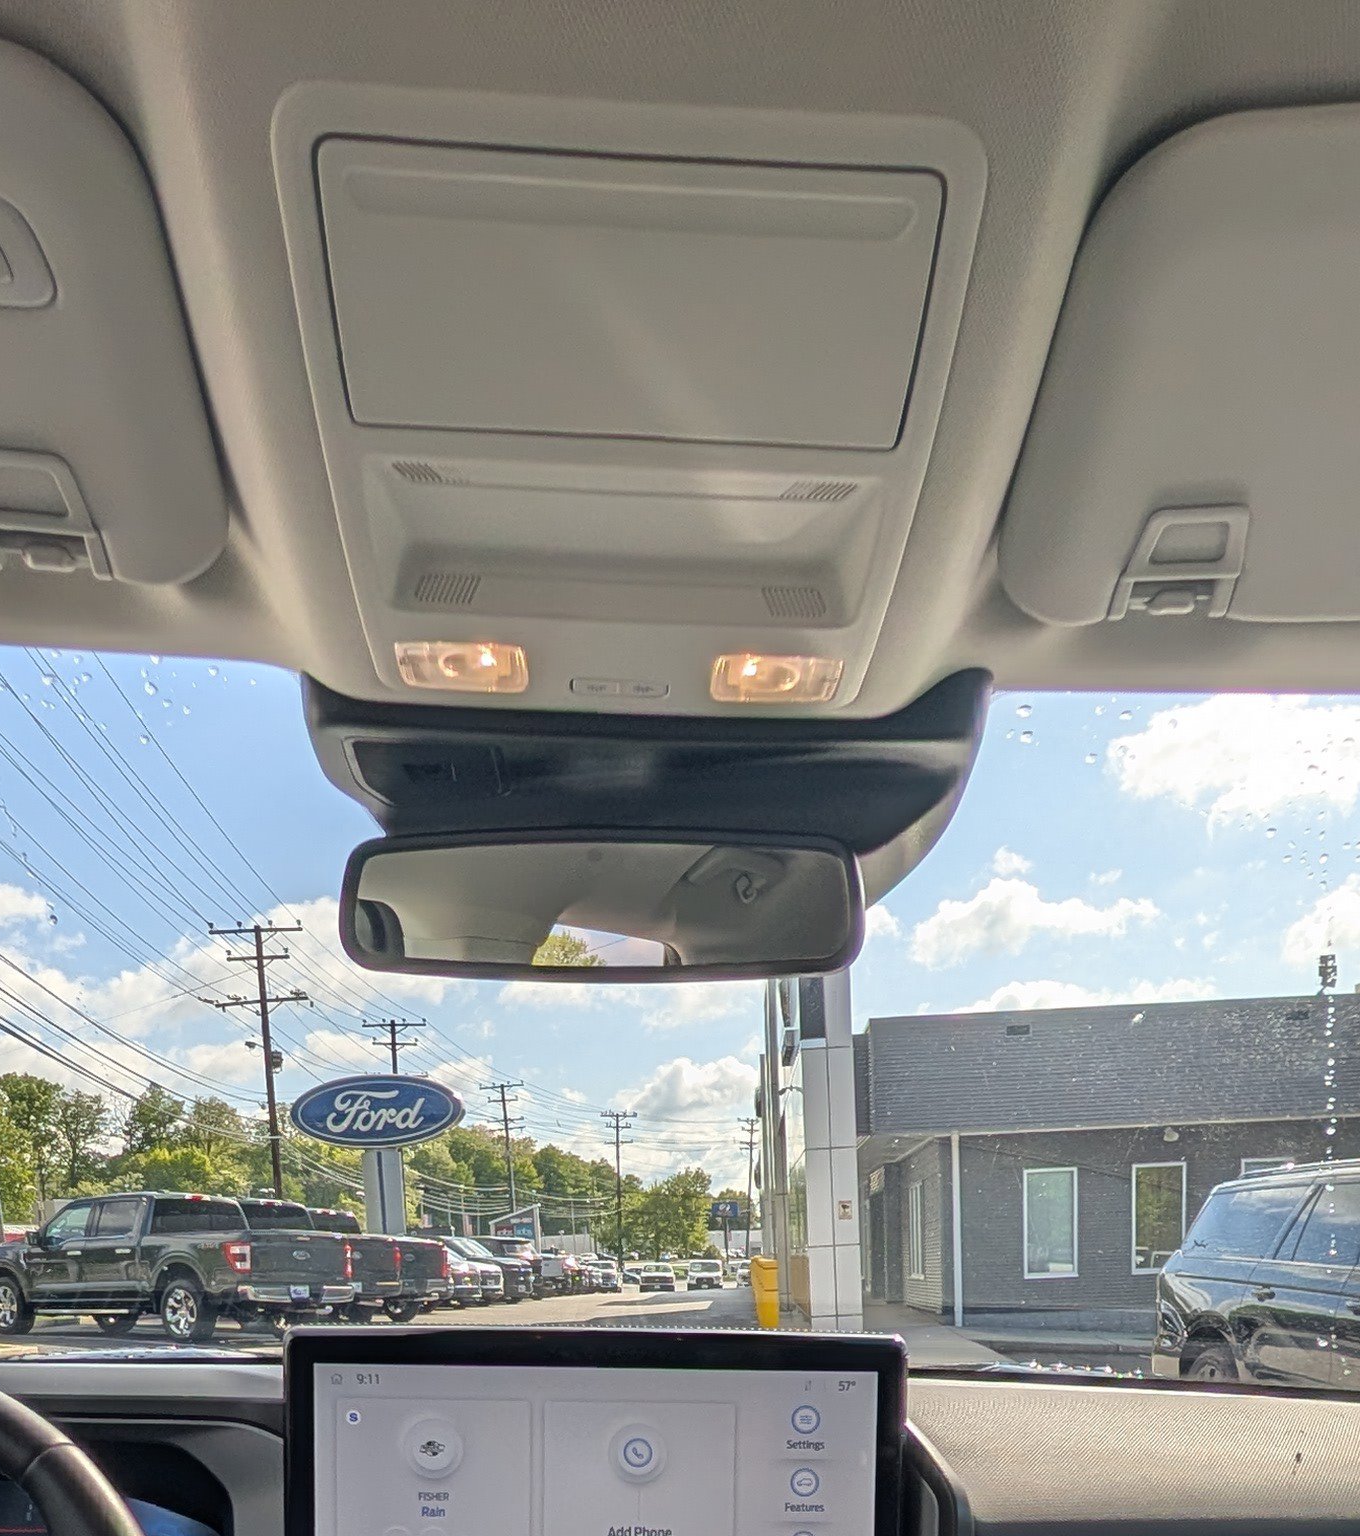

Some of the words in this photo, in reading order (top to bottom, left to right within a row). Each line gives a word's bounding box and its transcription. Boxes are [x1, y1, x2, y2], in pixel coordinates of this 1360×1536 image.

[326, 1090, 426, 1133] Ford
[356, 1373, 381, 1385] 9:11
[349, 1412, 358, 1422] S
[786, 1439, 825, 1451] Settings
[418, 1492, 450, 1501] FISHER
[421, 1506, 446, 1517] Rain
[784, 1502, 825, 1513] Features
